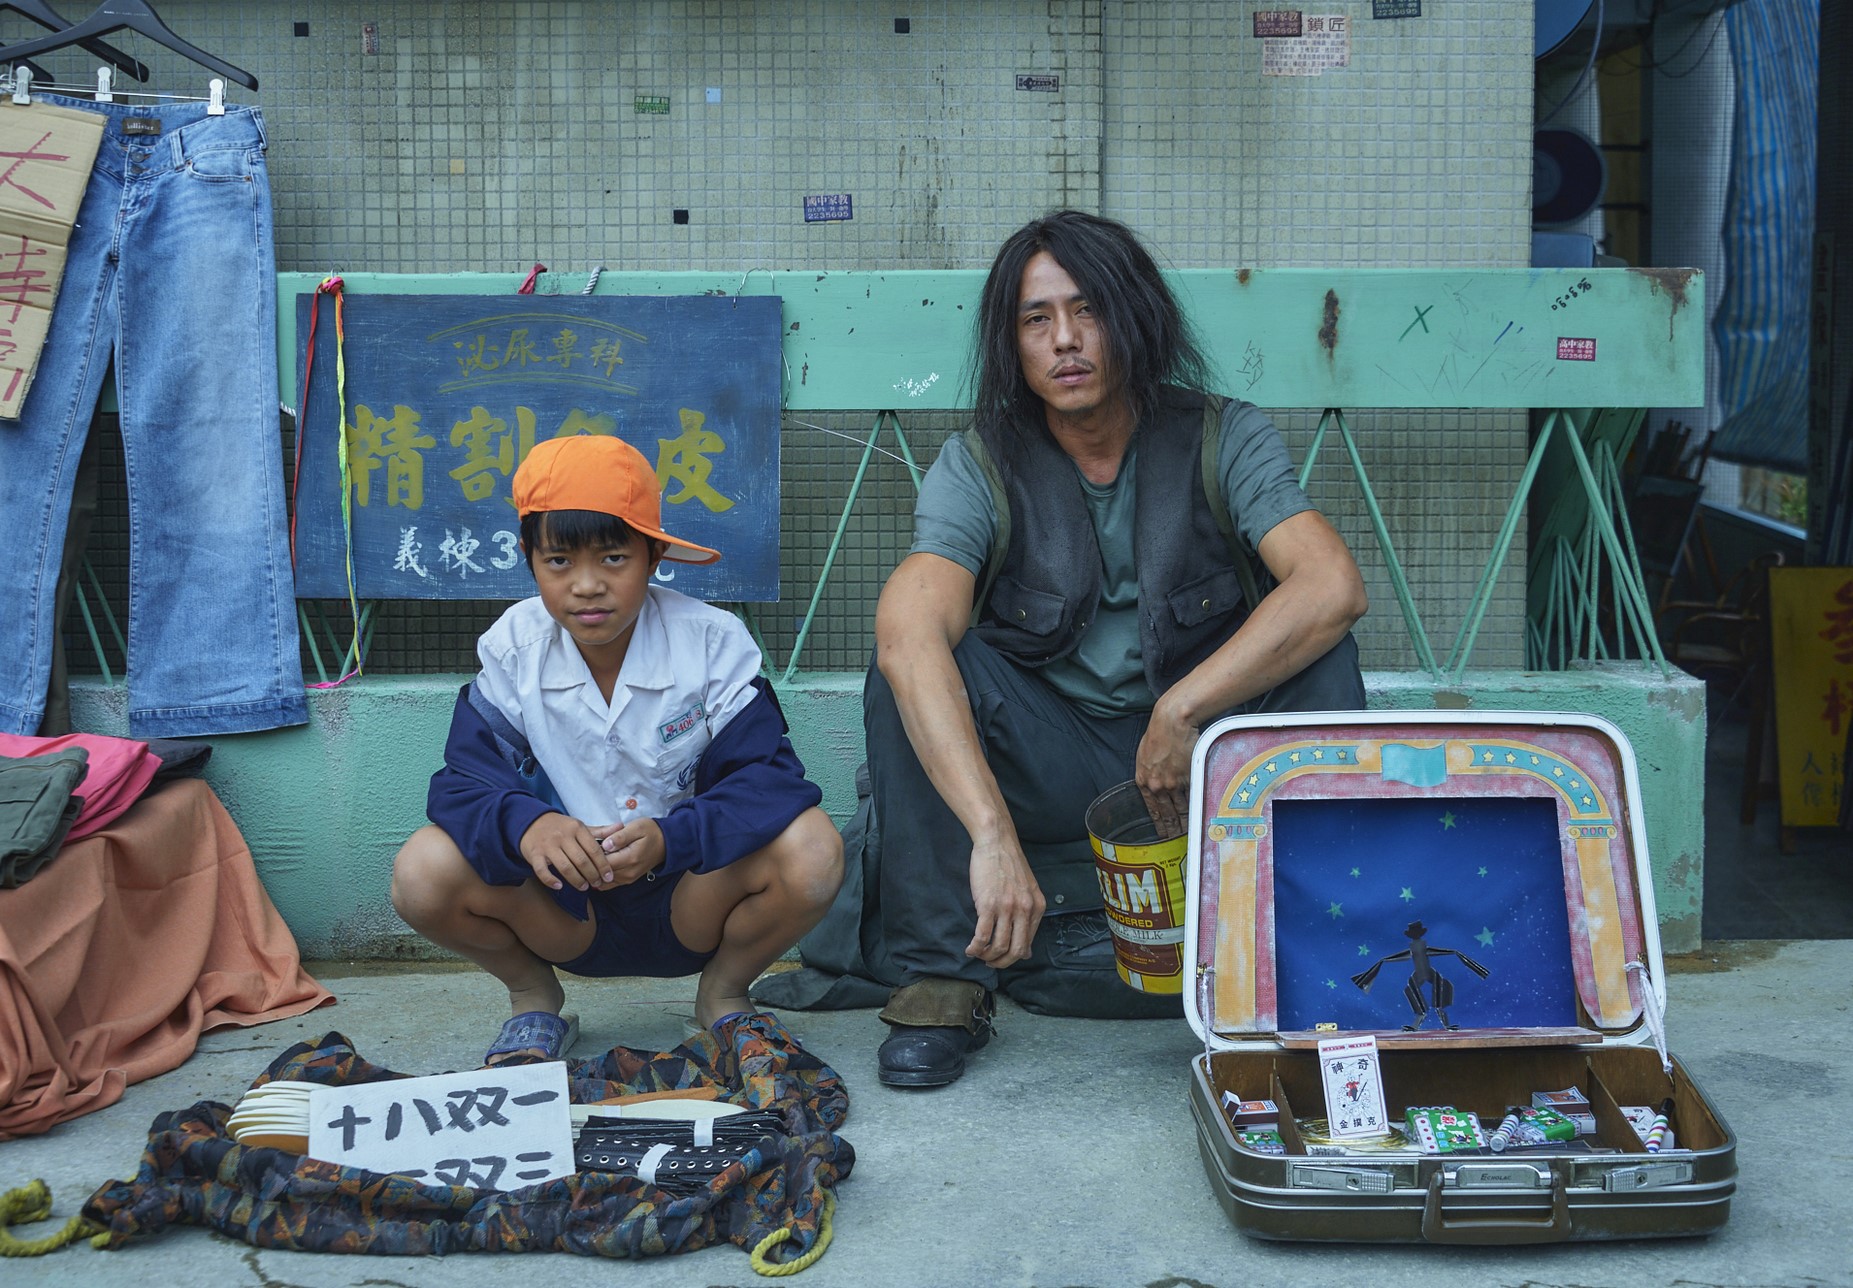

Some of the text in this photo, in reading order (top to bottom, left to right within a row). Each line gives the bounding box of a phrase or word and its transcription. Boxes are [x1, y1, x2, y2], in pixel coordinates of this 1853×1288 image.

[1307, 17, 1346, 32] 鎖匠
[808, 211, 849, 219] 2235695
[1559, 339, 1594, 349] 高中家教
[454, 328, 624, 378] 泌尿專科
[1331, 1058, 1369, 1074] 神奇
[1339, 1116, 1377, 1129] 金撲克
